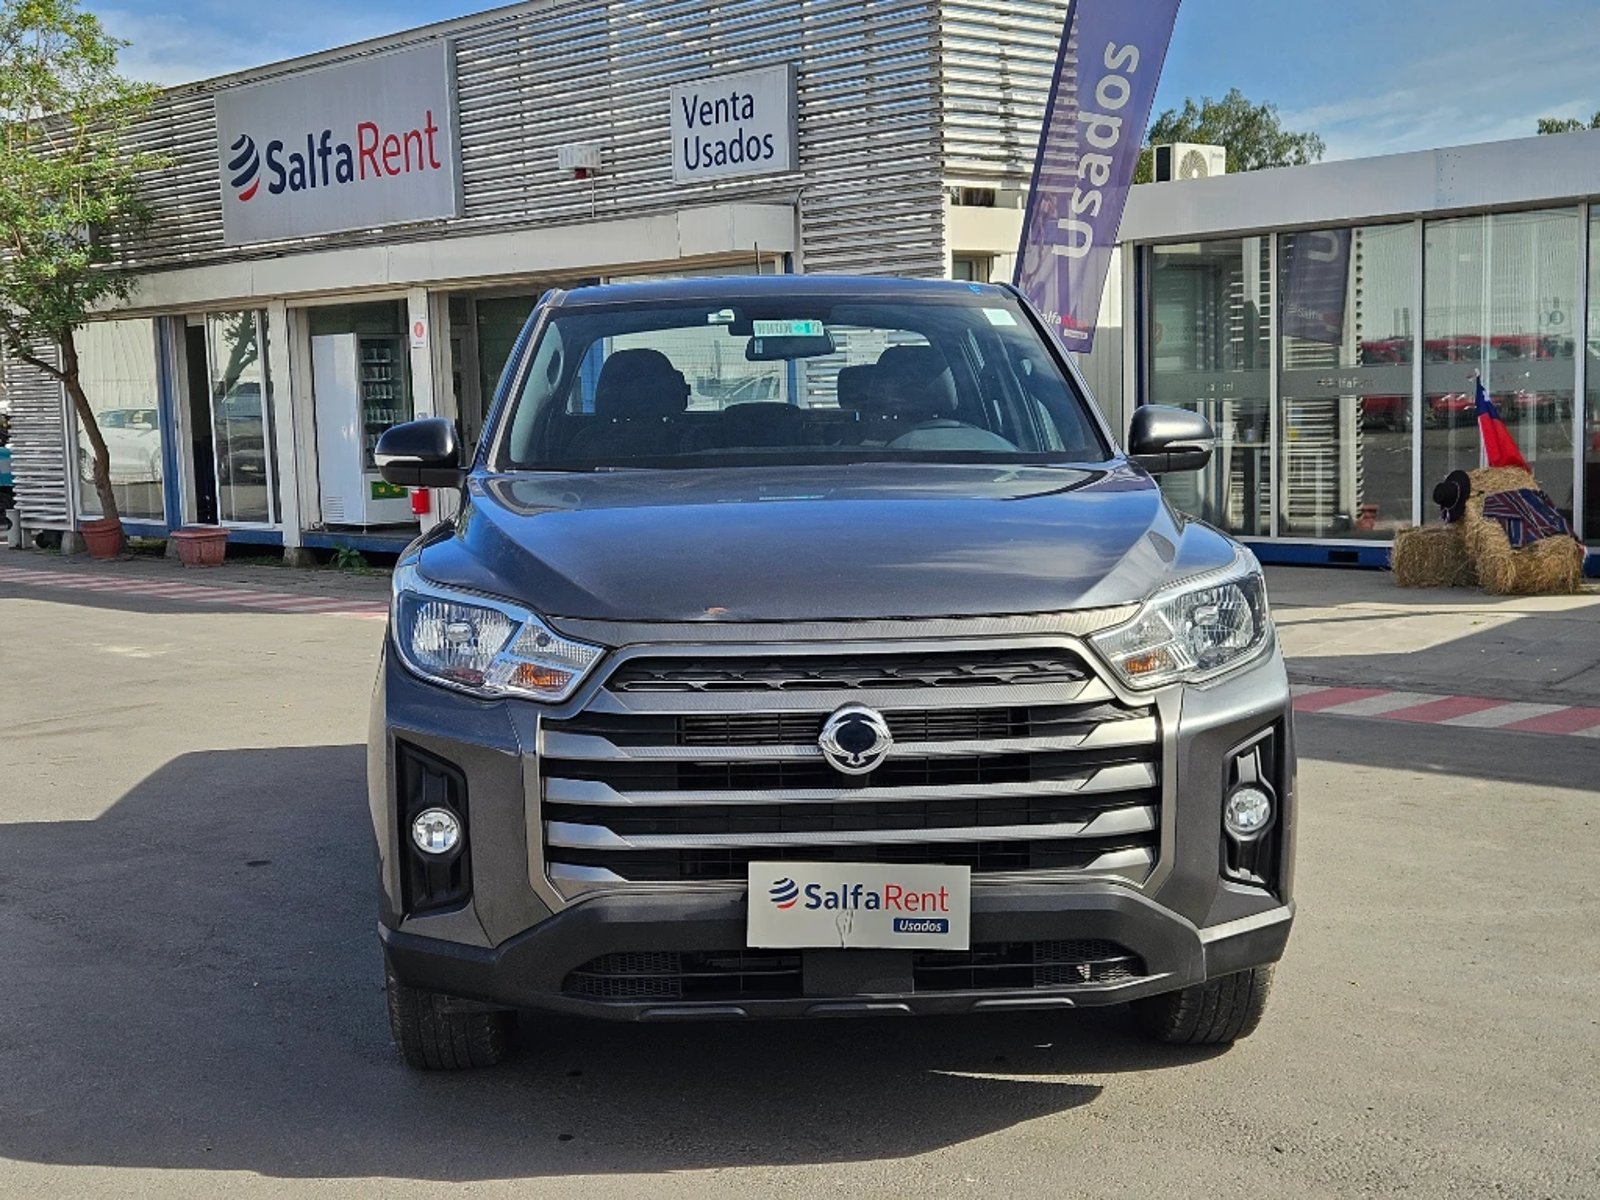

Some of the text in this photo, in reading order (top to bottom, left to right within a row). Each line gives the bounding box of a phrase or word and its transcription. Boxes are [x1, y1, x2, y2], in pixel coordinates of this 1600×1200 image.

[681, 91, 754, 129] Venta
[266, 110, 441, 194] SalfaRent
[684, 127, 774, 170] Usados
[1052, 41, 1140, 259] Usados
[804, 883, 950, 912] SalfaRent
[899, 919, 943, 933] Usados
